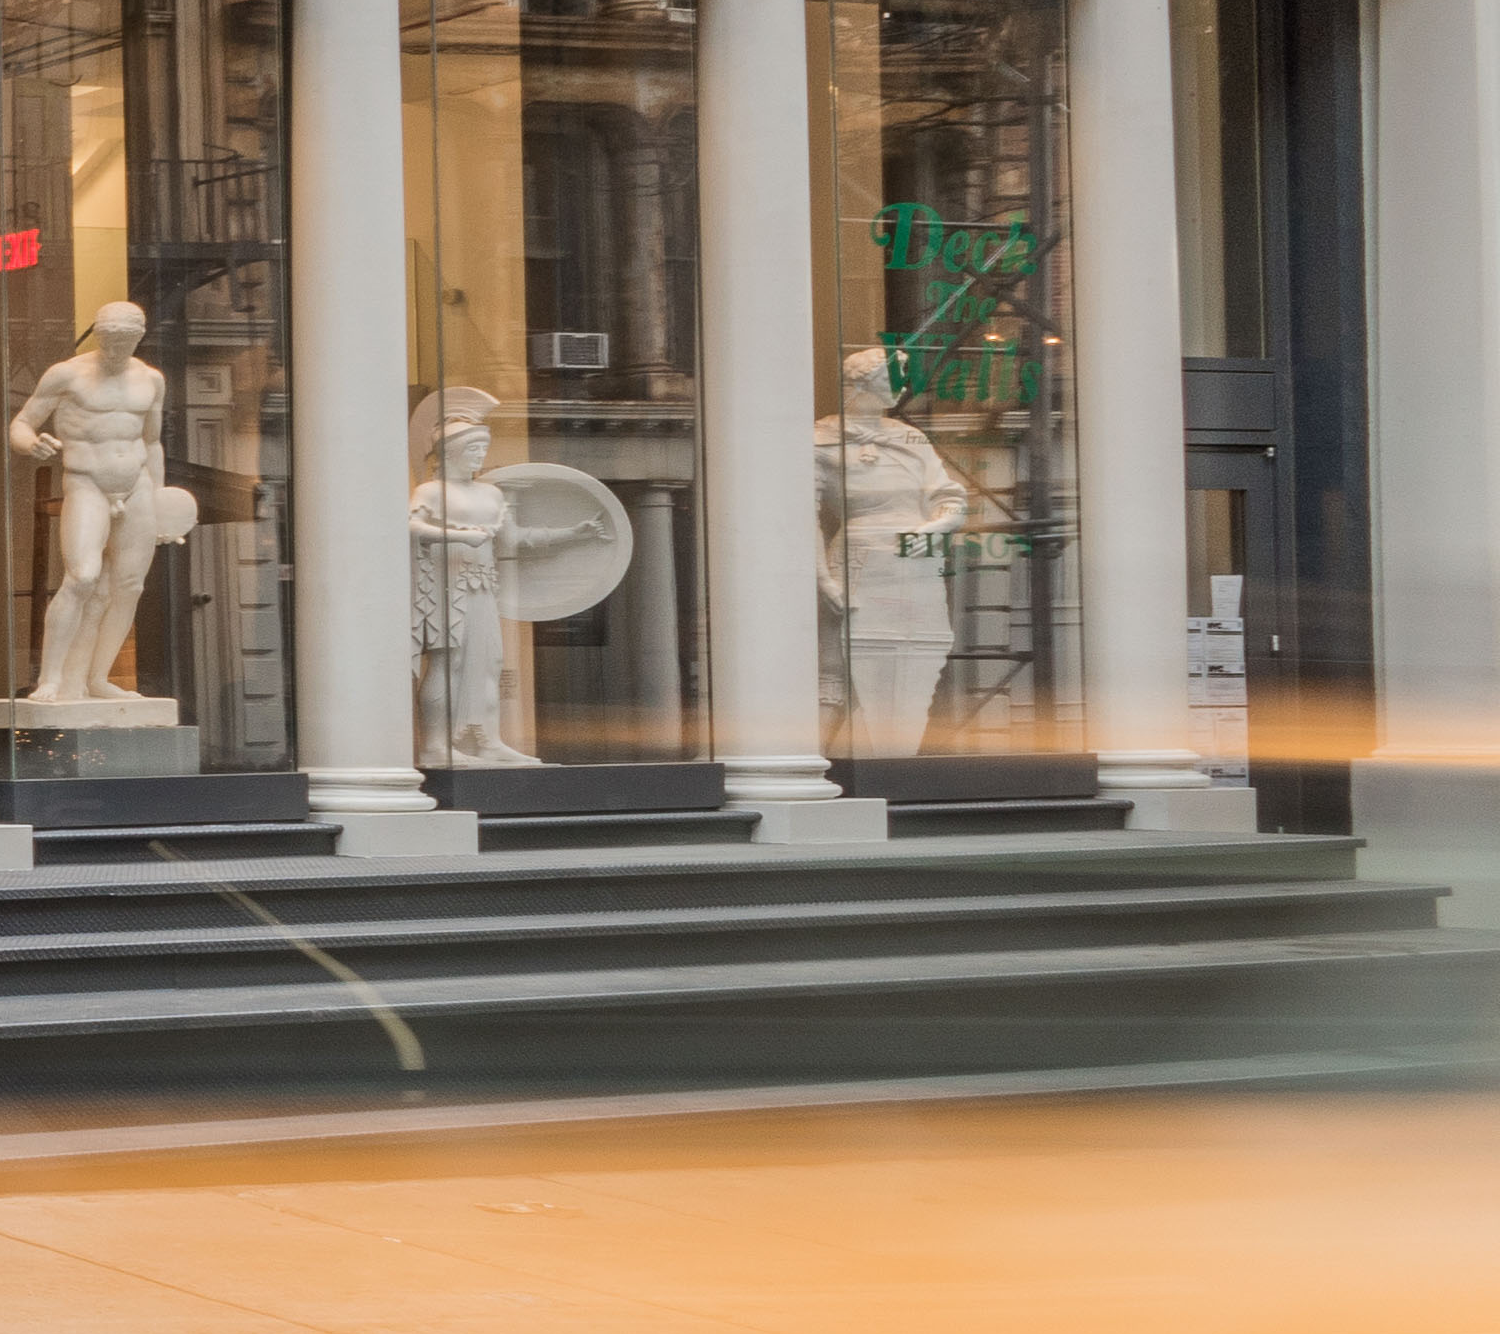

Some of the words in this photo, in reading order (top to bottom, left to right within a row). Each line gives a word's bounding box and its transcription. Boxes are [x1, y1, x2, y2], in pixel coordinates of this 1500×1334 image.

[870, 202, 1038, 275] Deck
[926, 280, 998, 324] The
[876, 331, 1043, 403] Walls
